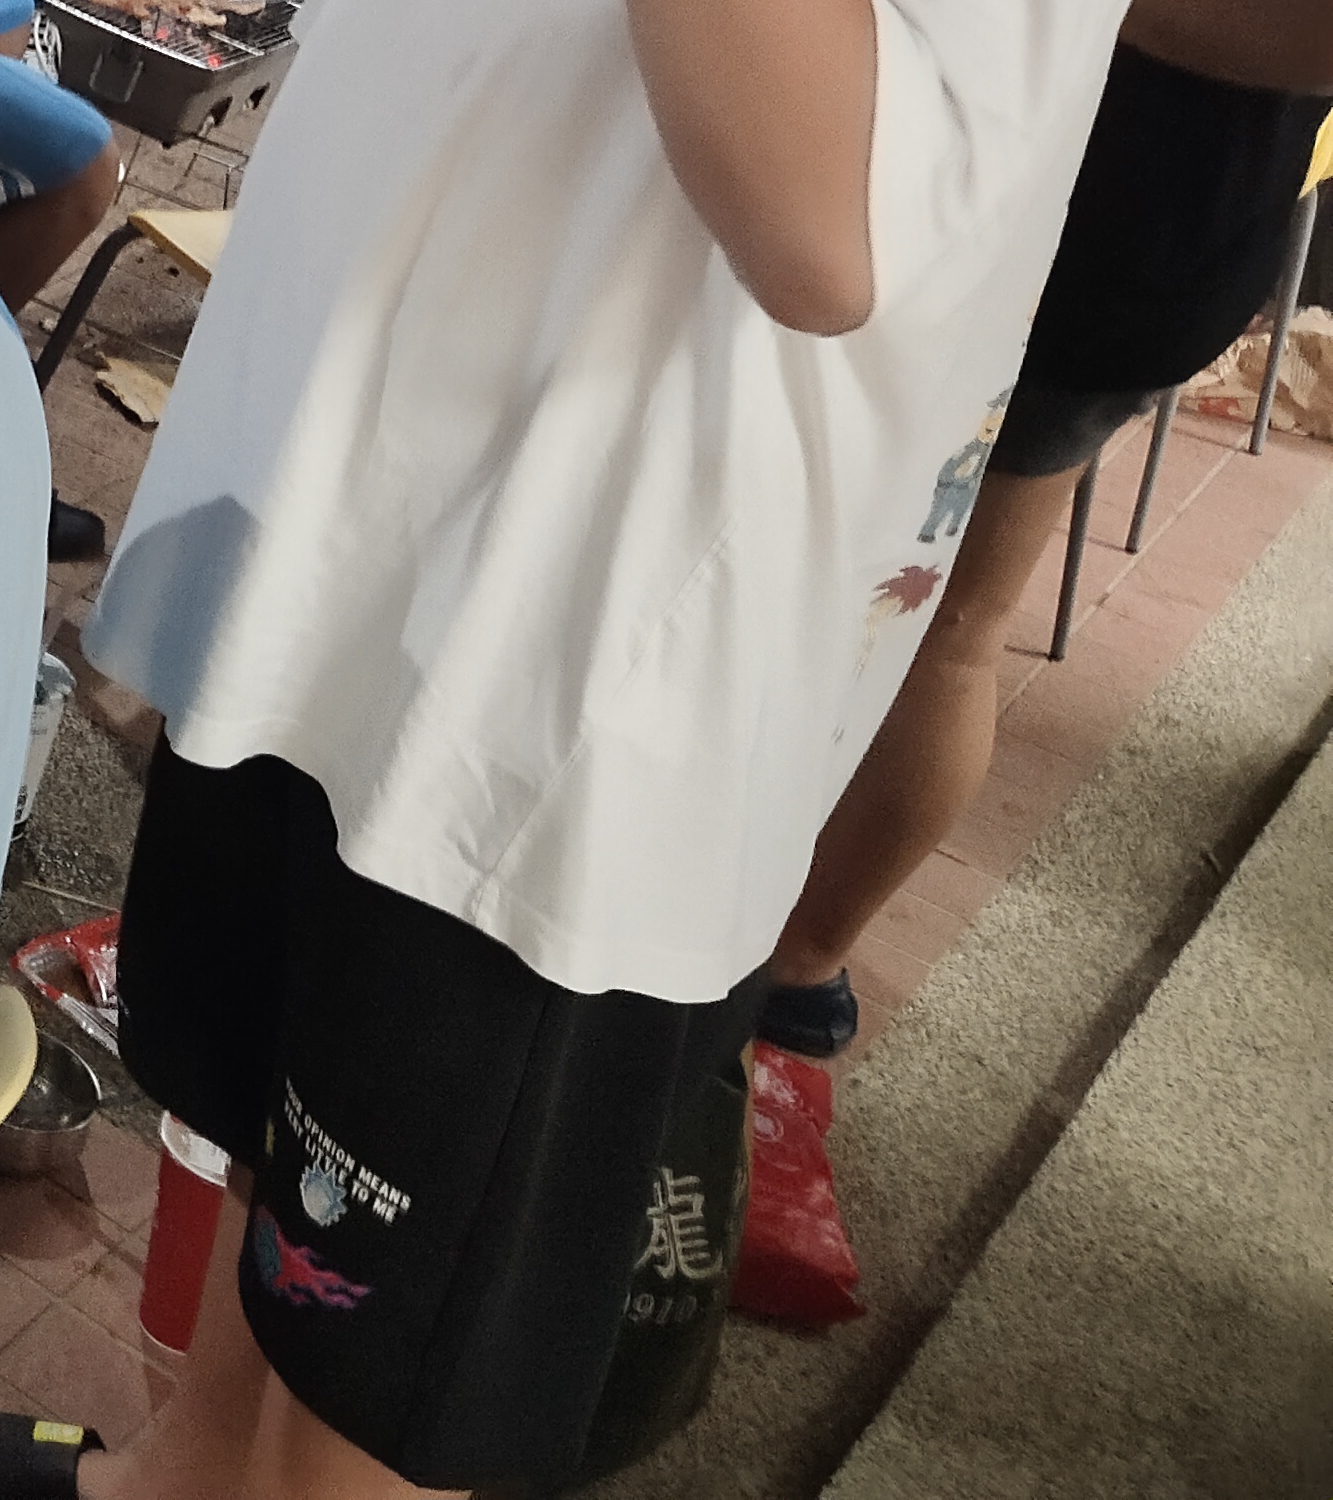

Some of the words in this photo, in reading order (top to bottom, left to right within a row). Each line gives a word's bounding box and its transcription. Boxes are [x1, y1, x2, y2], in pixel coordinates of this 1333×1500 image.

[304, 1114, 356, 1173] OPINION
[358, 1164, 411, 1213] MEANS
[305, 1135, 348, 1185] LITTLE
[351, 1178, 370, 1203] TO
[372, 1196, 399, 1224] ME
[634, 1166, 724, 1280] 龍
